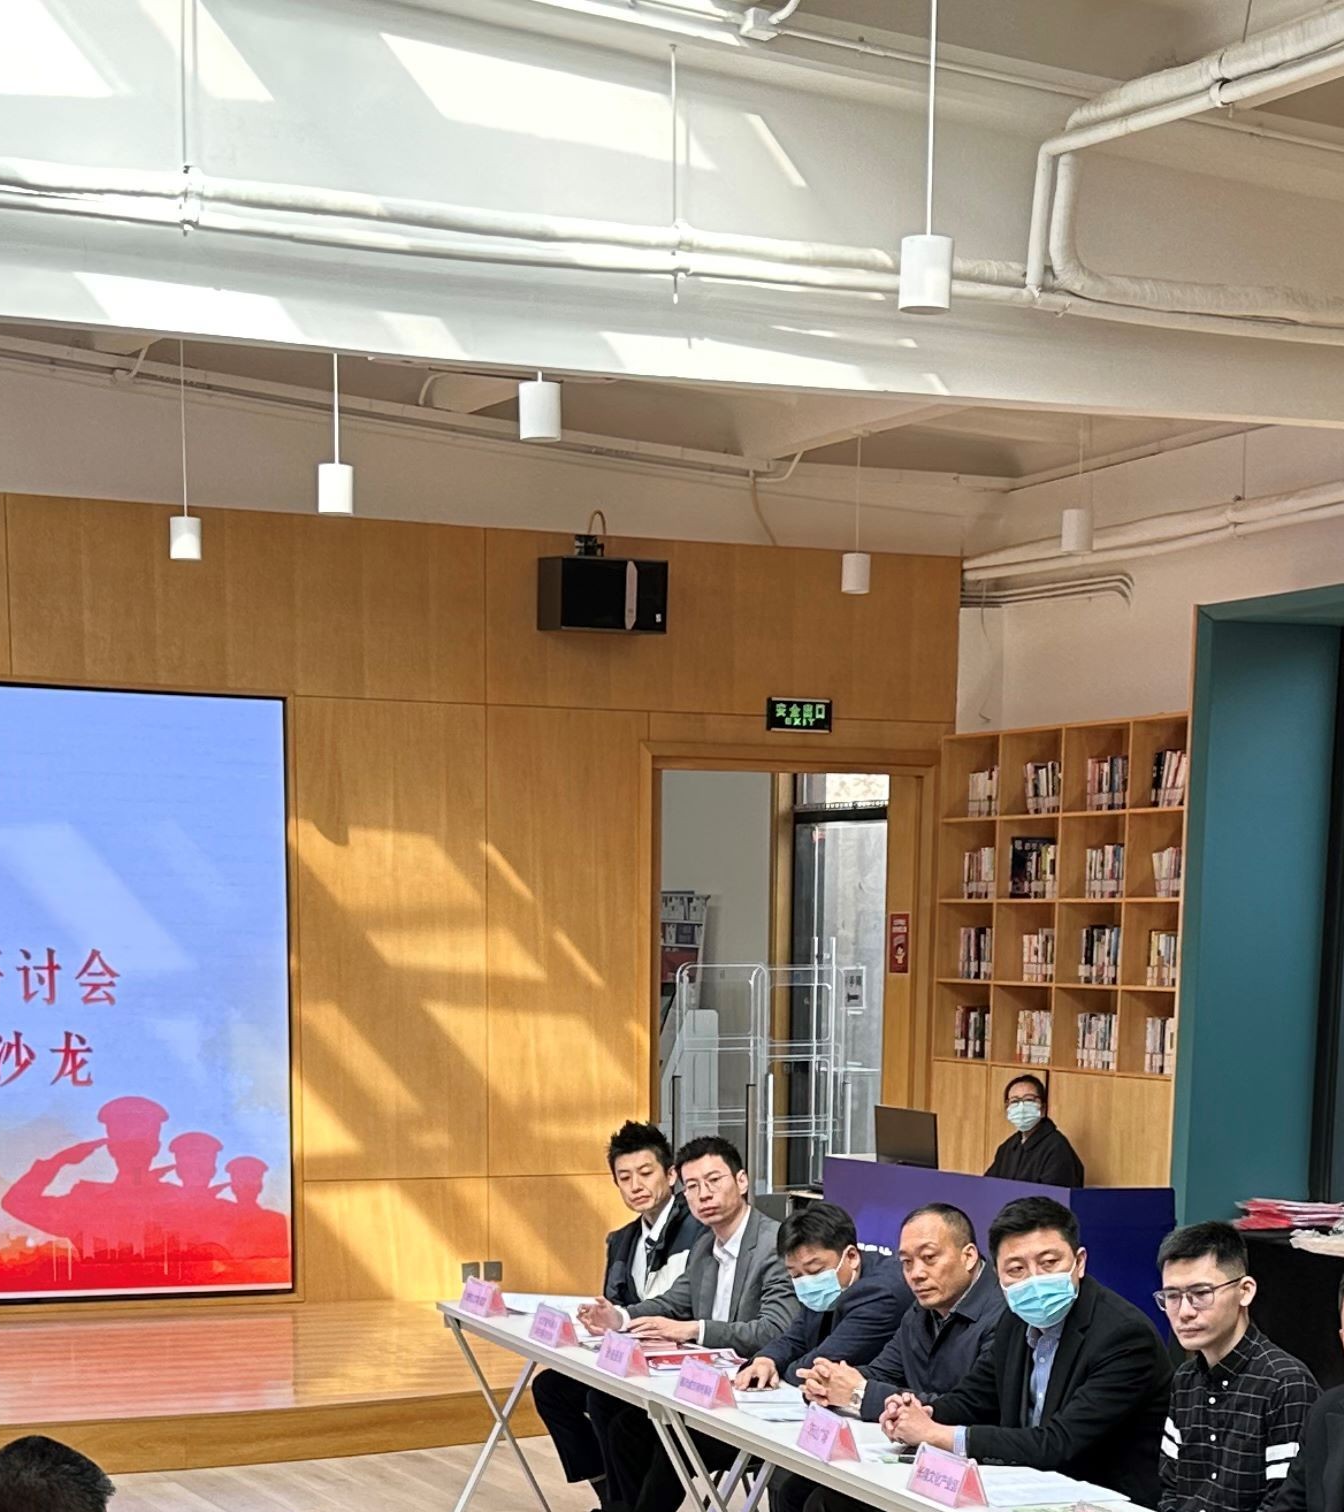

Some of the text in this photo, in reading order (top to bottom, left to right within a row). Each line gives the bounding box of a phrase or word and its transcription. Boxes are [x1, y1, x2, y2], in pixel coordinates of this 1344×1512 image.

[776, 703, 826, 719] 安全出口
[784, 717, 815, 726] EXIT
